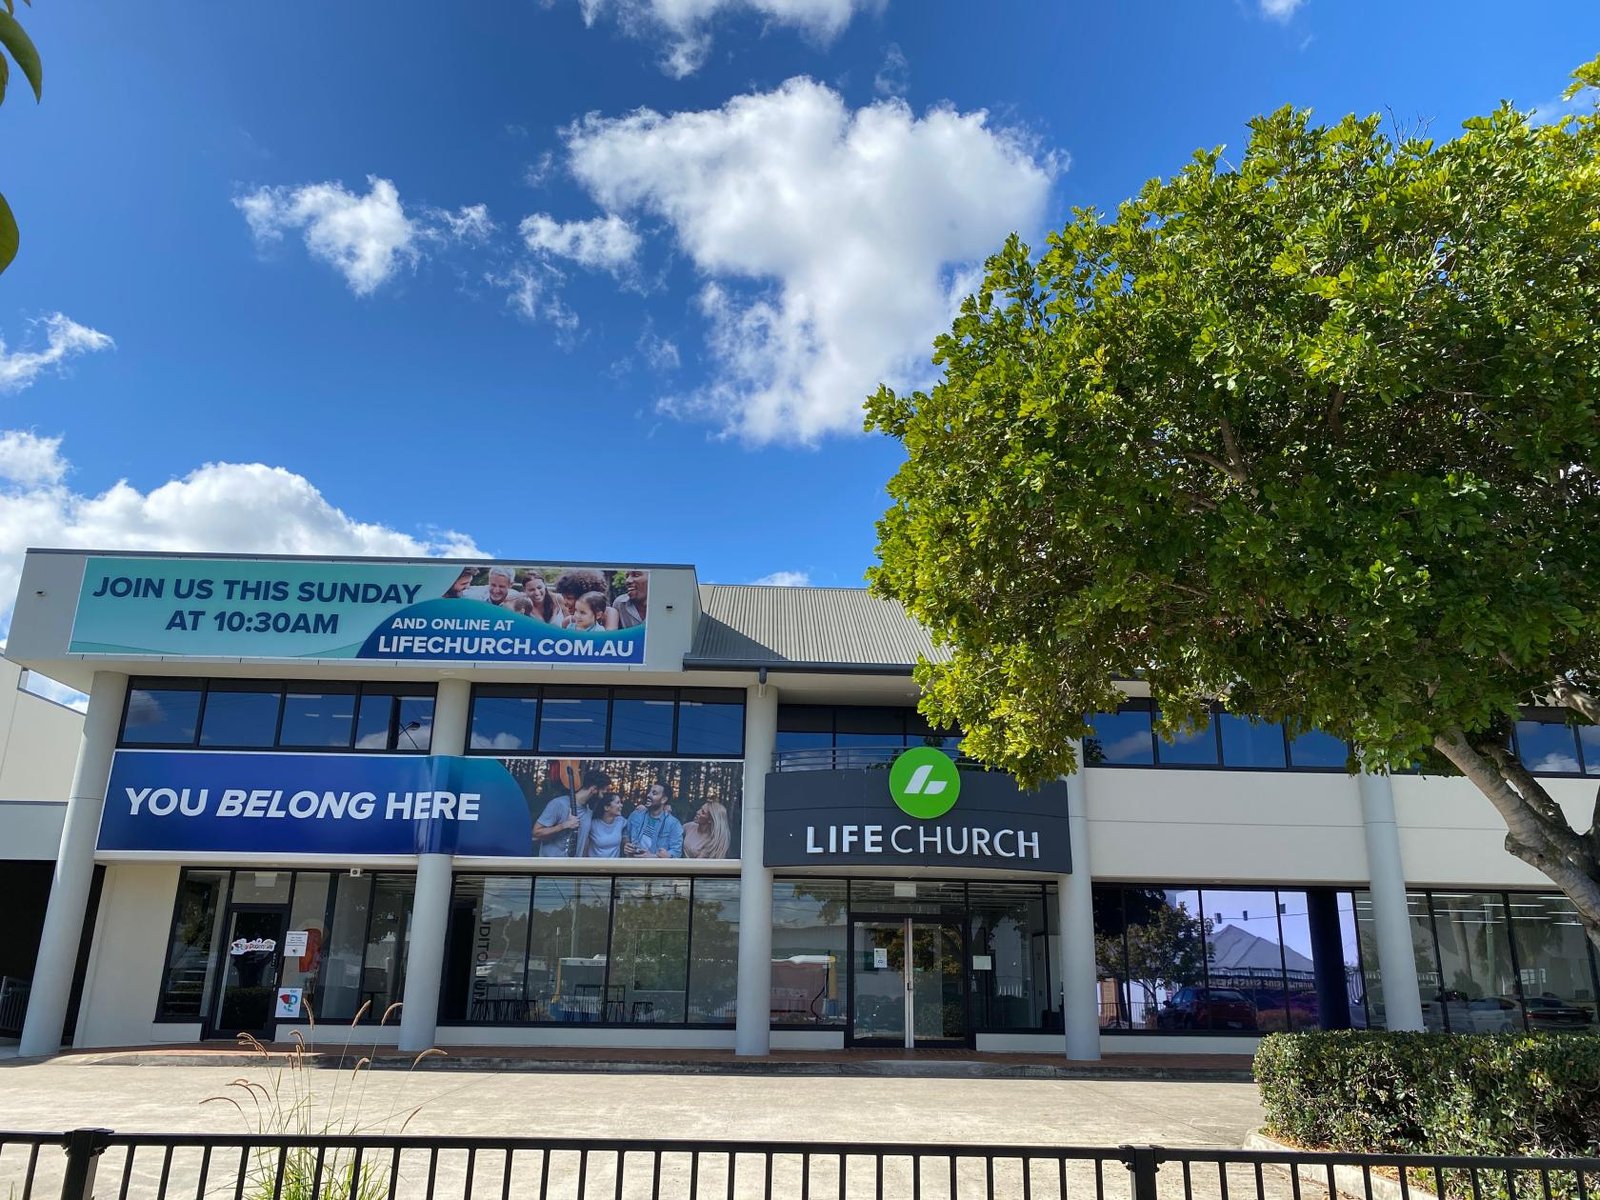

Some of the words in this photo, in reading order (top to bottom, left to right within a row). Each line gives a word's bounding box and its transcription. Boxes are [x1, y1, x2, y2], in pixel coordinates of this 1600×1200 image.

[92, 576, 165, 598] JOIN
[173, 578, 214, 599] US
[223, 579, 289, 601] THIS
[296, 581, 422, 604] SUNDAY
[165, 610, 206, 631] AT
[213, 611, 339, 634] 10:30AM
[391, 618, 427, 630] AND
[431, 618, 492, 631] ONLINE
[493, 620, 515, 631] AT
[378, 635, 634, 657] LIFECHURCH.COM.AU
[125, 787, 208, 816] YOU
[215, 789, 376, 819] BELONG
[385, 791, 481, 821] HERE
[806, 825, 883, 854] LIFE
[891, 825, 1040, 858] CHURCH
